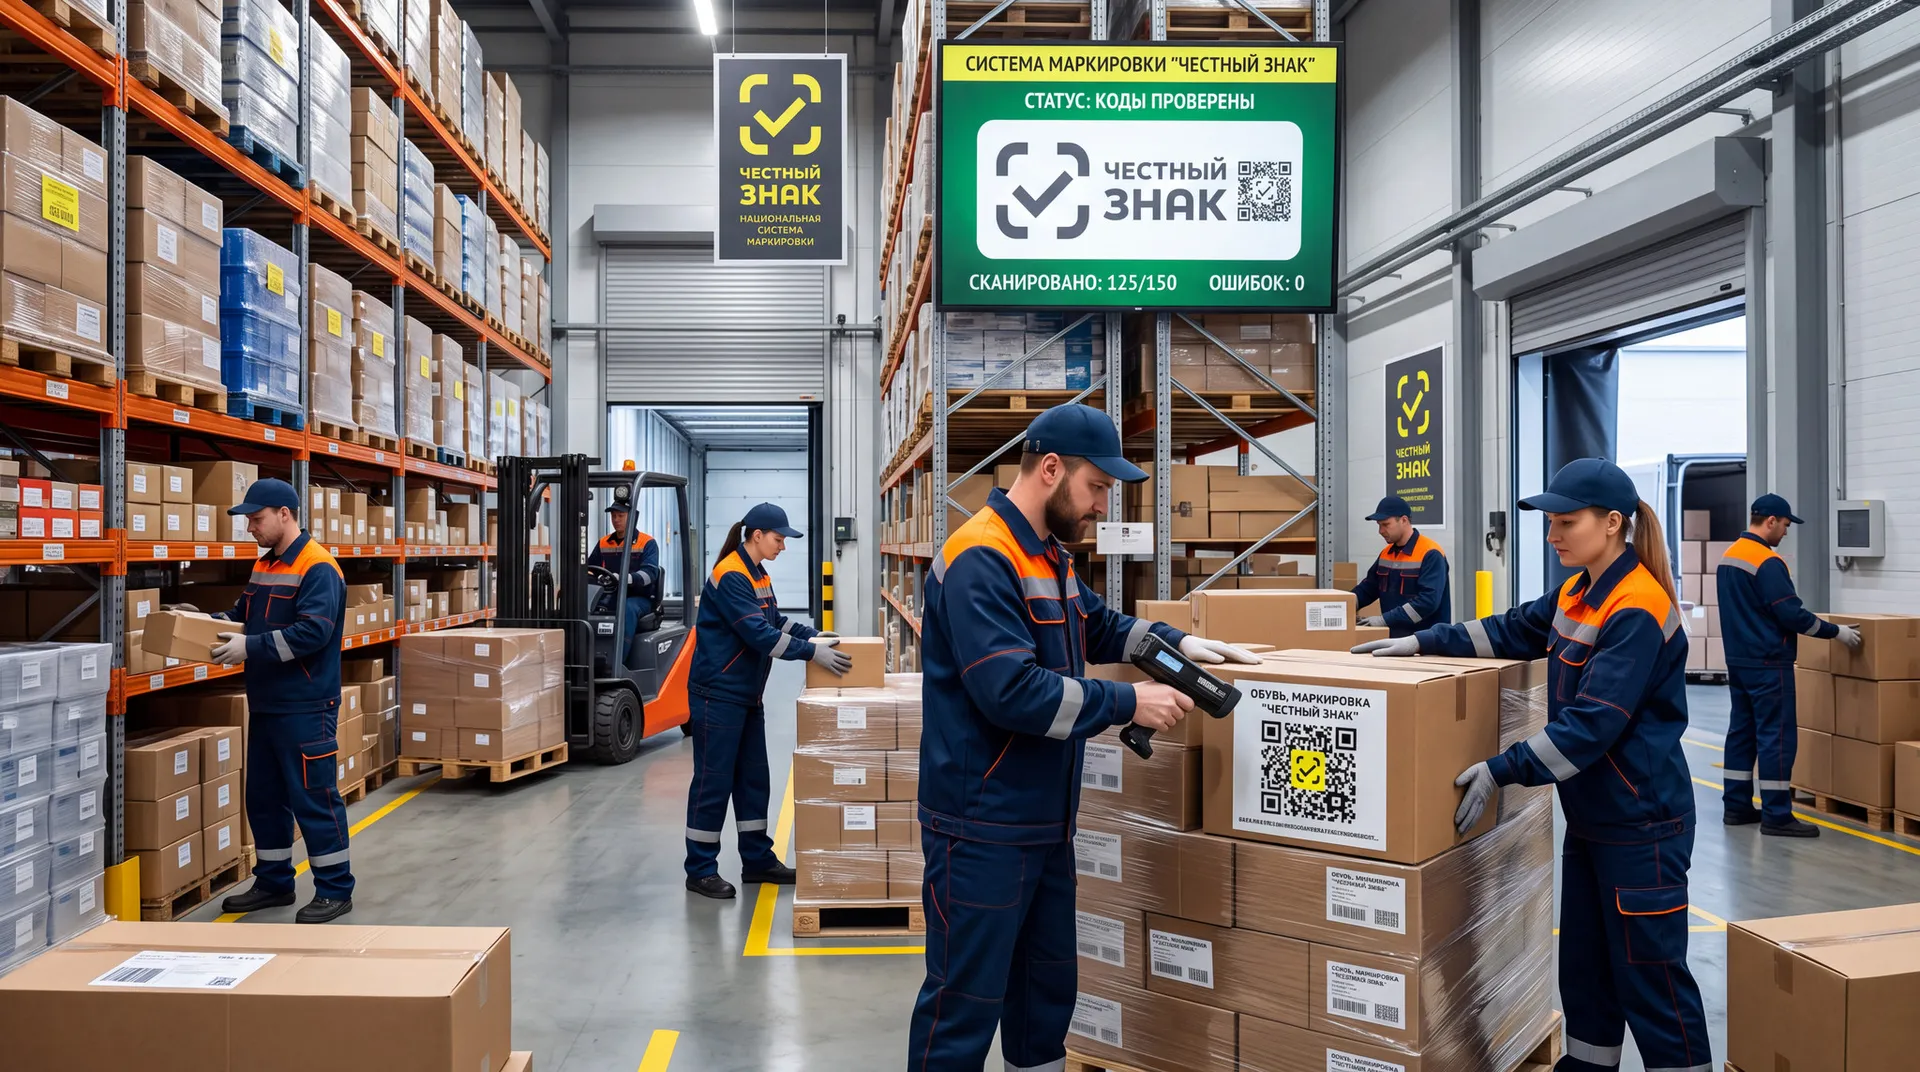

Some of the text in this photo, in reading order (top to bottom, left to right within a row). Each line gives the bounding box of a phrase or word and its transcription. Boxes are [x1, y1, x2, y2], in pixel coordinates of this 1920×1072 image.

[966, 54, 1315, 73] СИСТЕМА МАРКИРОВКИ "ЧЕСТНЫЙ ЗНАК"
[1025, 92, 1255, 111] СТАТУС: КОДЫ ПРОВЕРЕНЫ
[739, 164, 821, 180] ЧЕСТНЫЙ
[1104, 156, 1227, 180] ЧЕСТНЫЙ
[739, 184, 821, 206] ЗНАК
[1103, 188, 1227, 221] ЗНАК
[739, 214, 821, 224] НАЦИОНАЛЬНАЯ
[757, 225, 804, 235] СИСТЕМА
[746, 237, 815, 246] МАРКИРОВКИ
[969, 274, 1178, 293] СКАНИРОВАНО: 125/150
[1208, 274, 1305, 291] ОШИБОК: 0
[1396, 441, 1431, 458] ЧЕСТНЫЙ
[1396, 458, 1431, 480] ЗНАК
[1250, 688, 1371, 708] ОБУВЬ, МАРКИРОВКА
[1261, 703, 1359, 721] "ЧЕСТНЫЙ ЗНАК"
